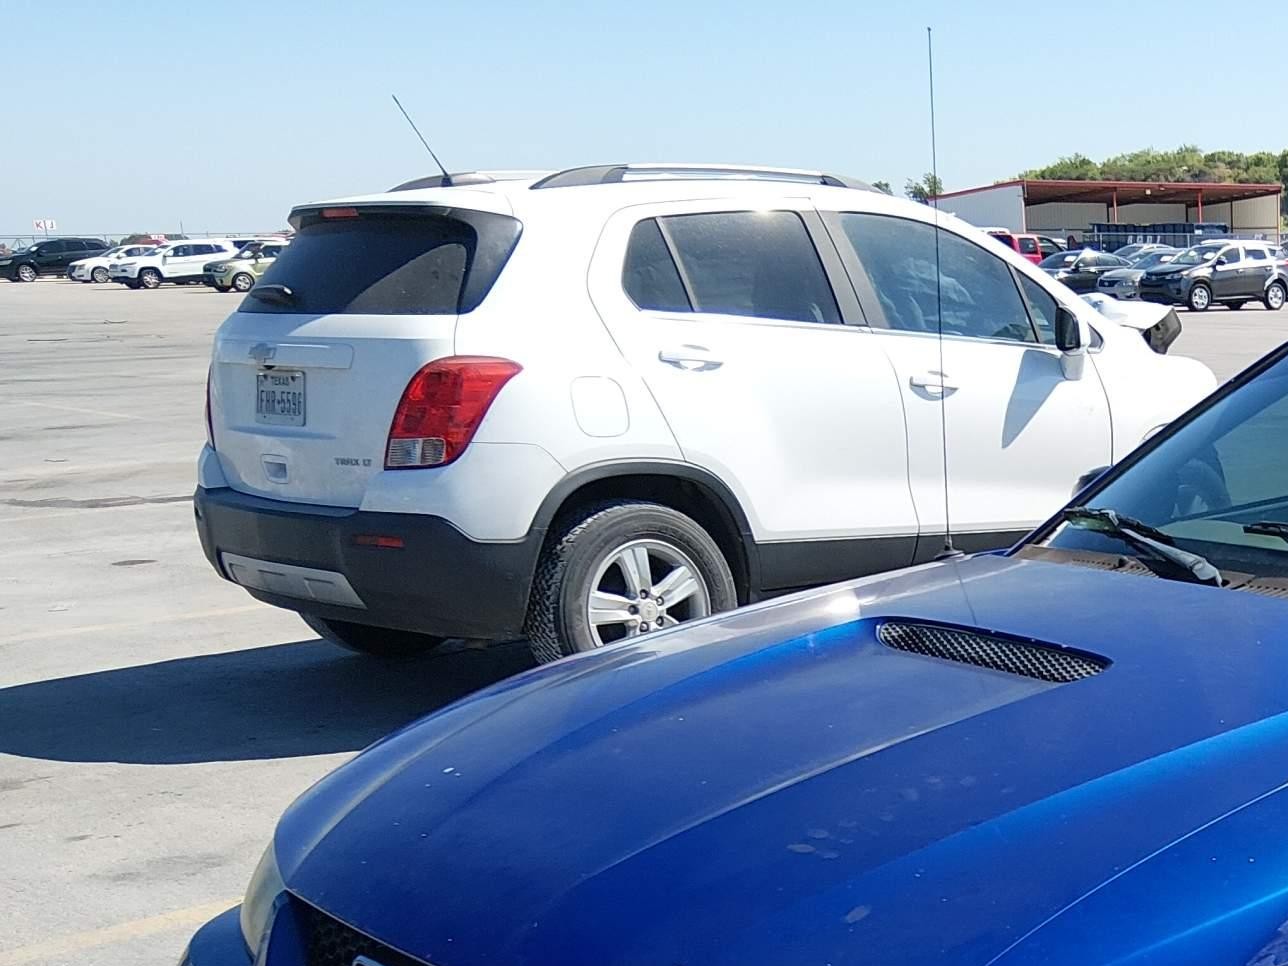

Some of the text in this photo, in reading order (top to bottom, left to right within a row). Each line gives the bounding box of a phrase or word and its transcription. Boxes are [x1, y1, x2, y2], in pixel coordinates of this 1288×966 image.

[271, 375, 289, 386] TEXAS
[334, 457, 372, 467] TRAX LT
